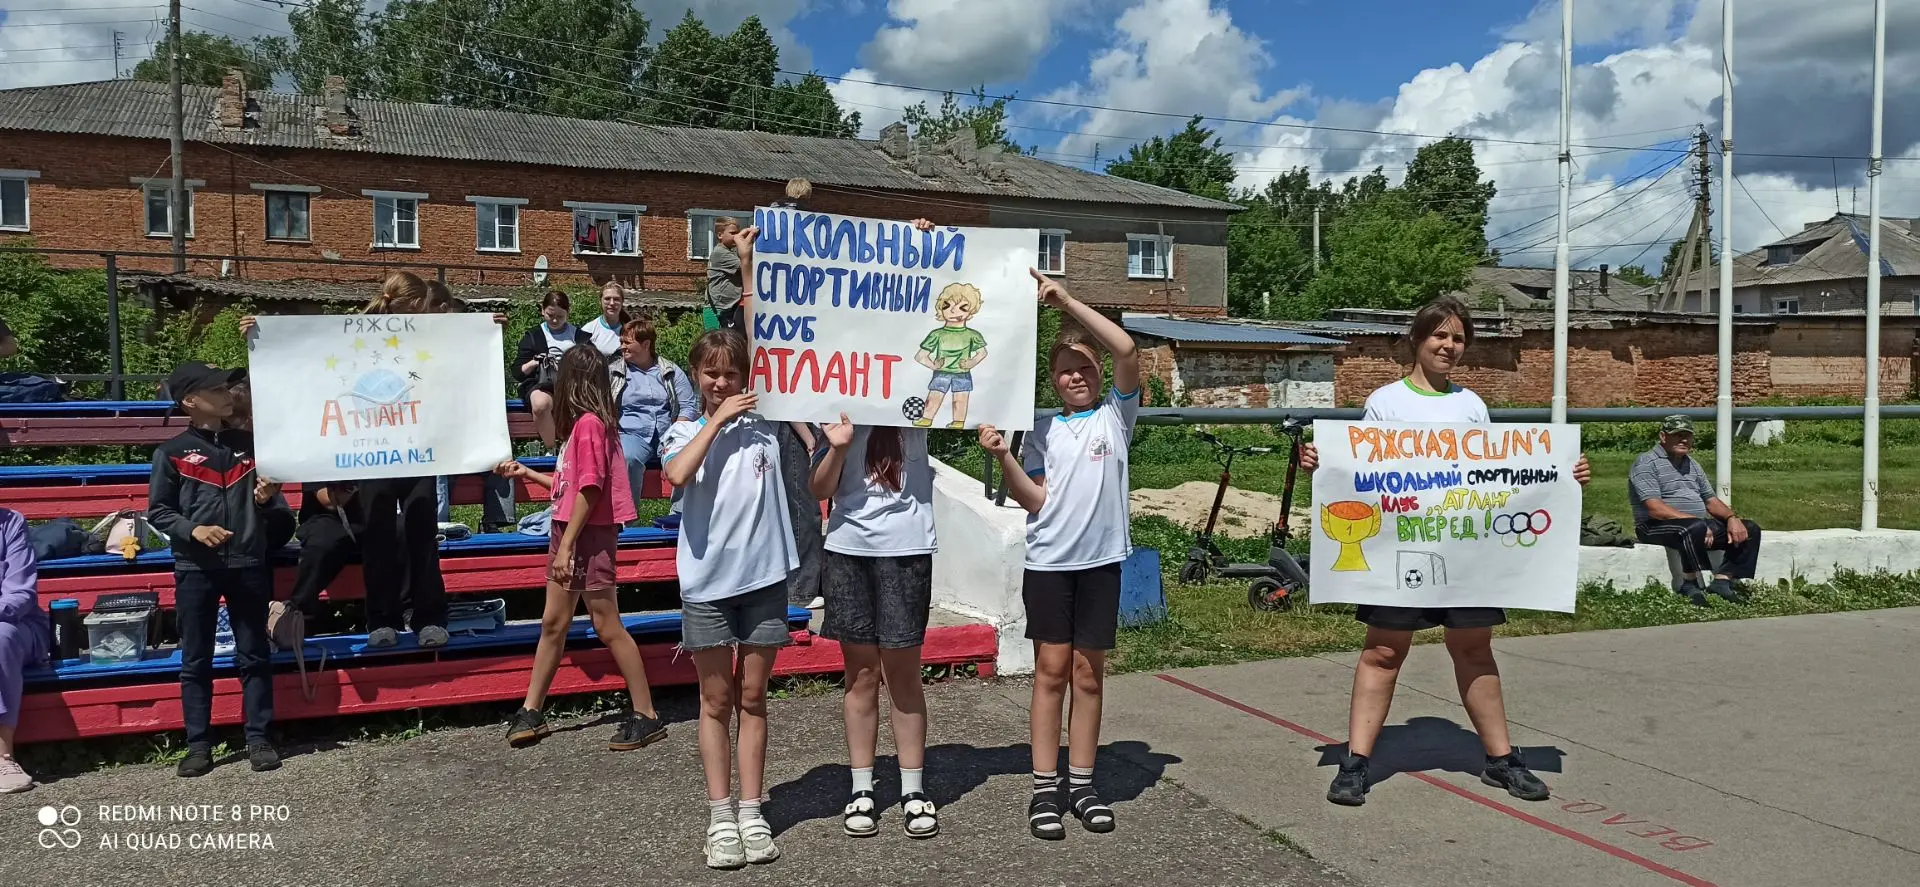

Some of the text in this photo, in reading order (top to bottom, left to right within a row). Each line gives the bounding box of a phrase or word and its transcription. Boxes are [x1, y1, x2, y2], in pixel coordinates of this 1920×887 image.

[755, 208, 966, 272] ШКОЛЬНЫЙ
[756, 261, 932, 314] СПОРТИВНЫЙ
[343, 316, 416, 334] РЯЖСК
[754, 312, 817, 343] КЛУБ
[750, 346, 902, 400] АТЛАНТ
[335, 449, 403, 469] ШКОЛА
[1348, 425, 1459, 463] РЯЖСКАЯ
[1354, 463, 1558, 494] ШКОЛЬНЫЙ СПОРТИВНЫЙ
[1381, 494, 1420, 514] КЛУБ
